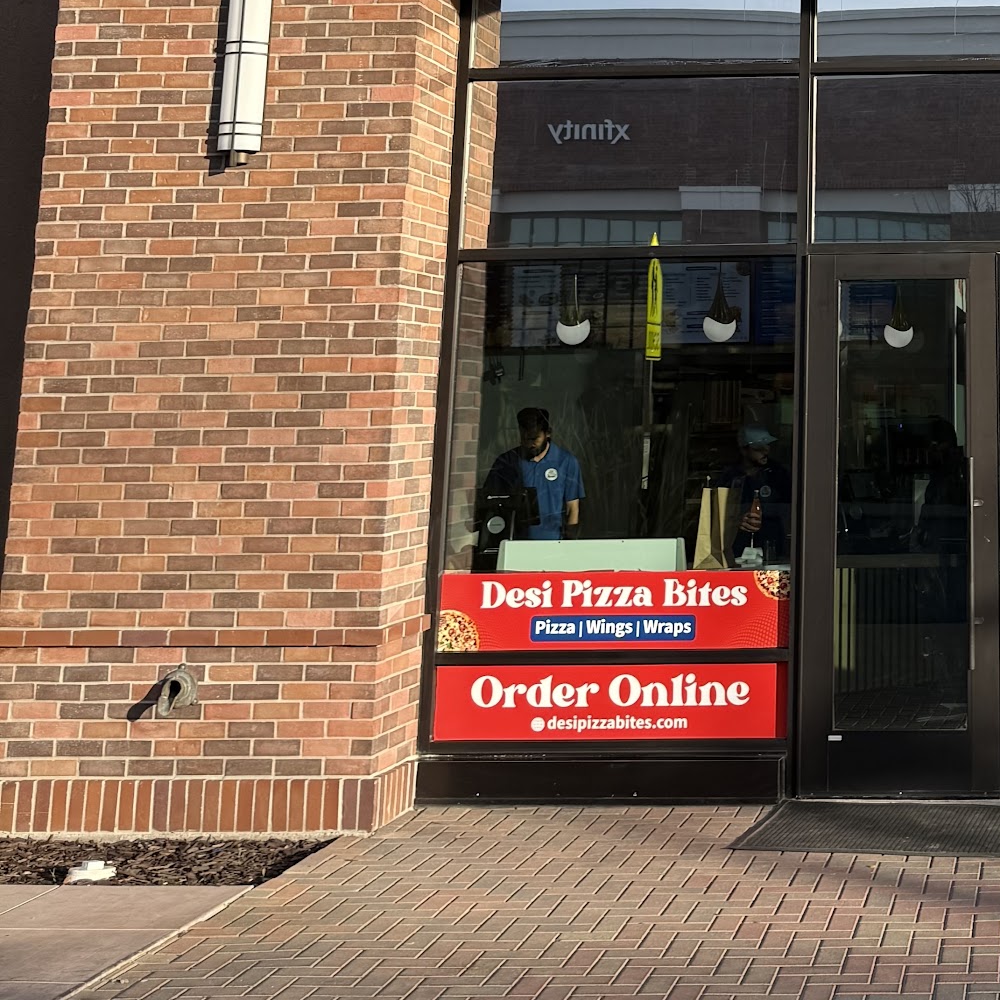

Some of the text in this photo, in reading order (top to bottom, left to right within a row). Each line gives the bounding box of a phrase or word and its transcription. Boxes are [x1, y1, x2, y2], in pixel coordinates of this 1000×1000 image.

[480, 578, 748, 609] Desi Pizza Bites
[535, 618, 576, 635] Pizza
[585, 618, 634, 638] Wings
[643, 618, 692, 638] Wraps
[470, 672, 751, 708] Order Online
[546, 714, 688, 733] desipizzabites.com
